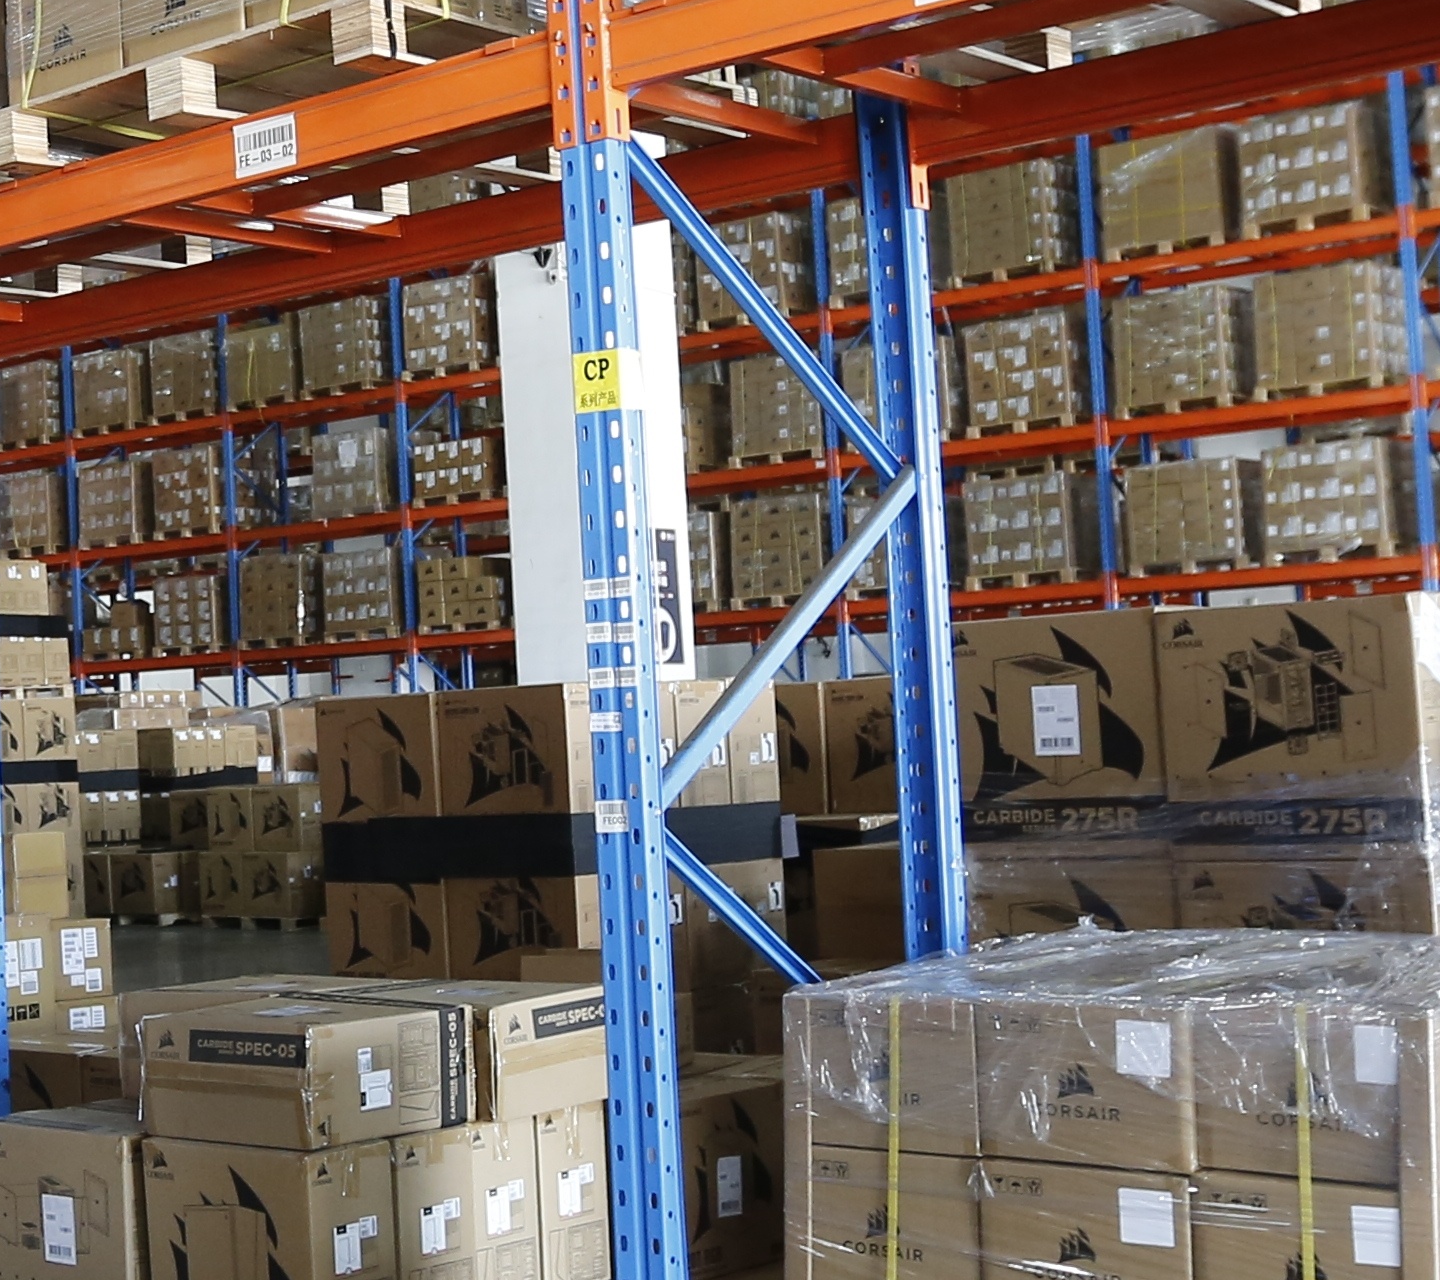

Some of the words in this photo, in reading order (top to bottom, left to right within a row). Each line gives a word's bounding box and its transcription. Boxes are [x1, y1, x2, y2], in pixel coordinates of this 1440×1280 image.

[239, 142, 294, 168] FE-03-02
[583, 357, 609, 381] CP
[579, 390, 617, 408] 系列产品
[974, 809, 1056, 824] CARBIDE
[1061, 807, 1138, 831] 275R
[1200, 810, 1293, 825] CARBIDE
[1299, 808, 1387, 834] 275R
[197, 1038, 234, 1050] CARBIDE
[236, 1041, 297, 1058] SPEC-05
